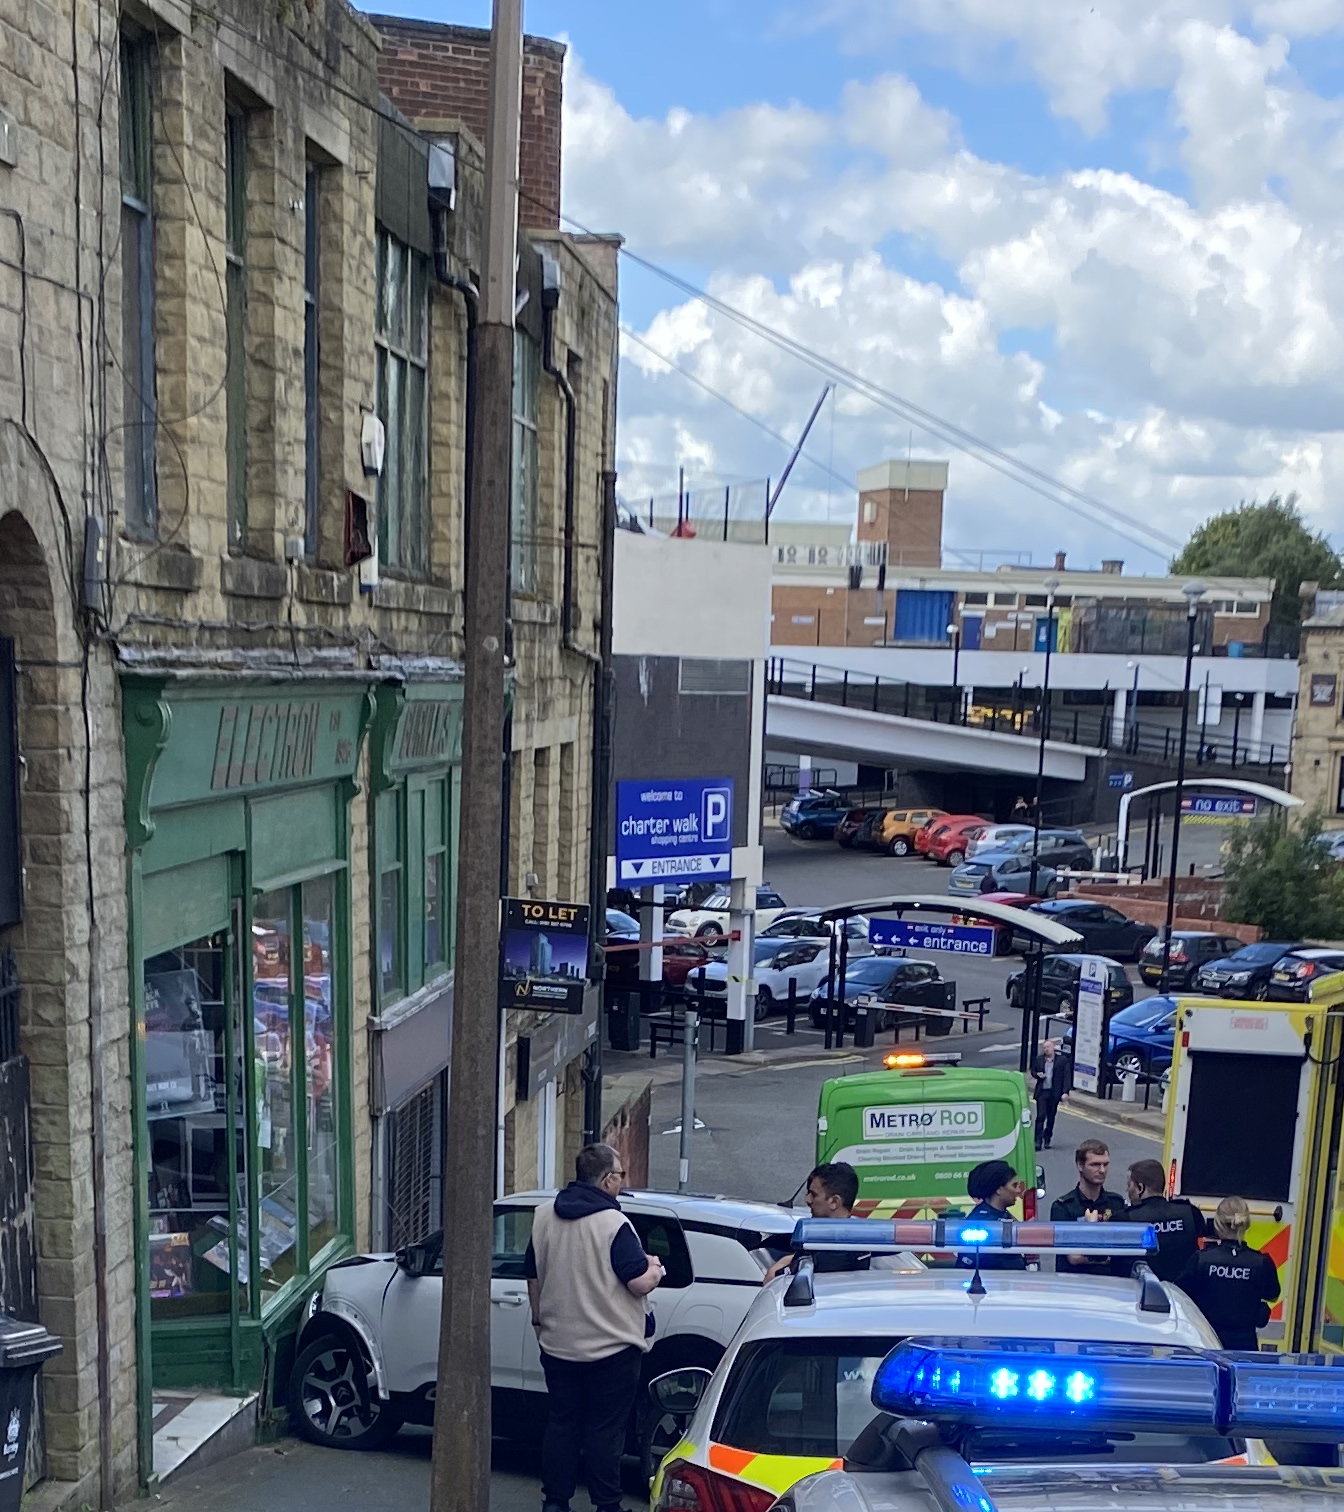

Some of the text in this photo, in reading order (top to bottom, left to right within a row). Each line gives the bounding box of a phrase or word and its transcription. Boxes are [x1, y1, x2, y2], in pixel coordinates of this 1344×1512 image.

[640, 789, 684, 802] welcome to
[1195, 799, 1240, 813] no exit
[621, 812, 699, 836] charter walk
[651, 834, 699, 846] shopping centre
[651, 858, 702, 875] ENTRANCE
[521, 904, 578, 921] TO LET
[914, 925, 947, 936] exit only
[923, 936, 988, 953] entrance
[1153, 1219, 1184, 1233] OLICE
[1209, 1265, 1251, 1280] POLICE
